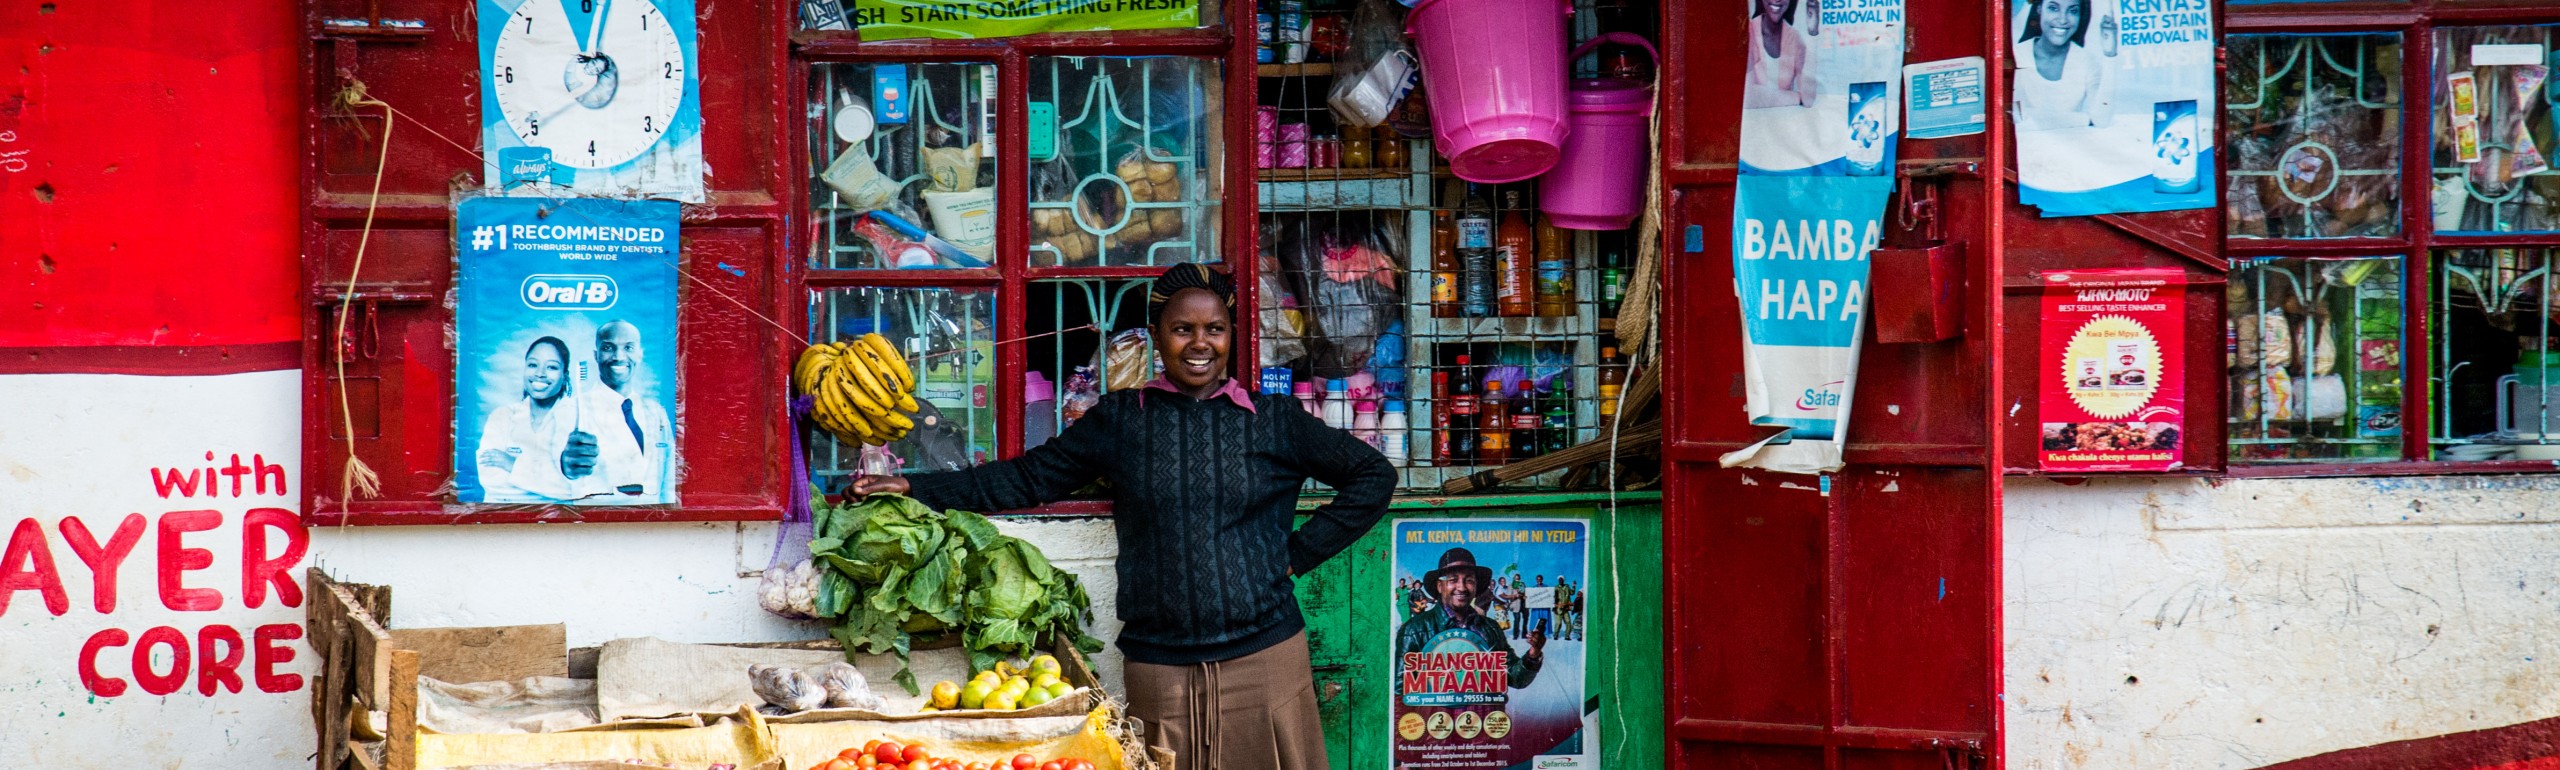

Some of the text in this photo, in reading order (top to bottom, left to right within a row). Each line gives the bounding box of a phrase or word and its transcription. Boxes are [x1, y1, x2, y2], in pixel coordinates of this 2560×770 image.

[901, 3, 971, 23] START
[977, 0, 1111, 19] SOMETHING
[1822, 9, 1900, 25] REMOVAL IN
[525, 17, 533, 35] 7
[641, 14, 647, 31] 1
[2121, 13, 2207, 31] BEST STAIN
[2121, 29, 2209, 46] REMOVAL IN
[505, 66, 513, 84] 6
[664, 61, 672, 79] 2
[530, 119, 538, 136] 5
[644, 115, 652, 133] 3
[588, 140, 595, 157] 4
[512, 160, 547, 178] always
[471, 224, 665, 251] #1 RECOMMENDED
[1743, 218, 1880, 261] BAMBA
[513, 243, 664, 254] TOOTHBRUSH BRAND BY DENTISTS
[559, 252, 618, 261] WORLD WIDE
[1760, 278, 1865, 322] HAPA
[2059, 304, 2075, 312] BEST
[2077, 304, 2105, 312] SELLING
[2128, 303, 2167, 311] ENHANCER
[2118, 331, 2140, 339] Mpya
[925, 389, 962, 399] DOUBLEMINT
[2068, 453, 2097, 461] chakula
[150, 450, 287, 499] with
[1406, 530, 1576, 545] MT. KENYA, RAUNDI HII NI YETU!
[0, 507, 310, 618] AYER
[78, 623, 304, 697] CORE
[1404, 650, 1508, 671] SHANGWE
[1404, 671, 1508, 694] MTAANI
[1406, 695, 1420, 703] SMS
[1421, 697, 1435, 705] your
[1436, 695, 1455, 703] NAME
[1463, 694, 1485, 702] 29555
[1438, 713, 1444, 725] 3
[1465, 713, 1472, 725] 8
[1540, 759, 1578, 768] Safaricom
